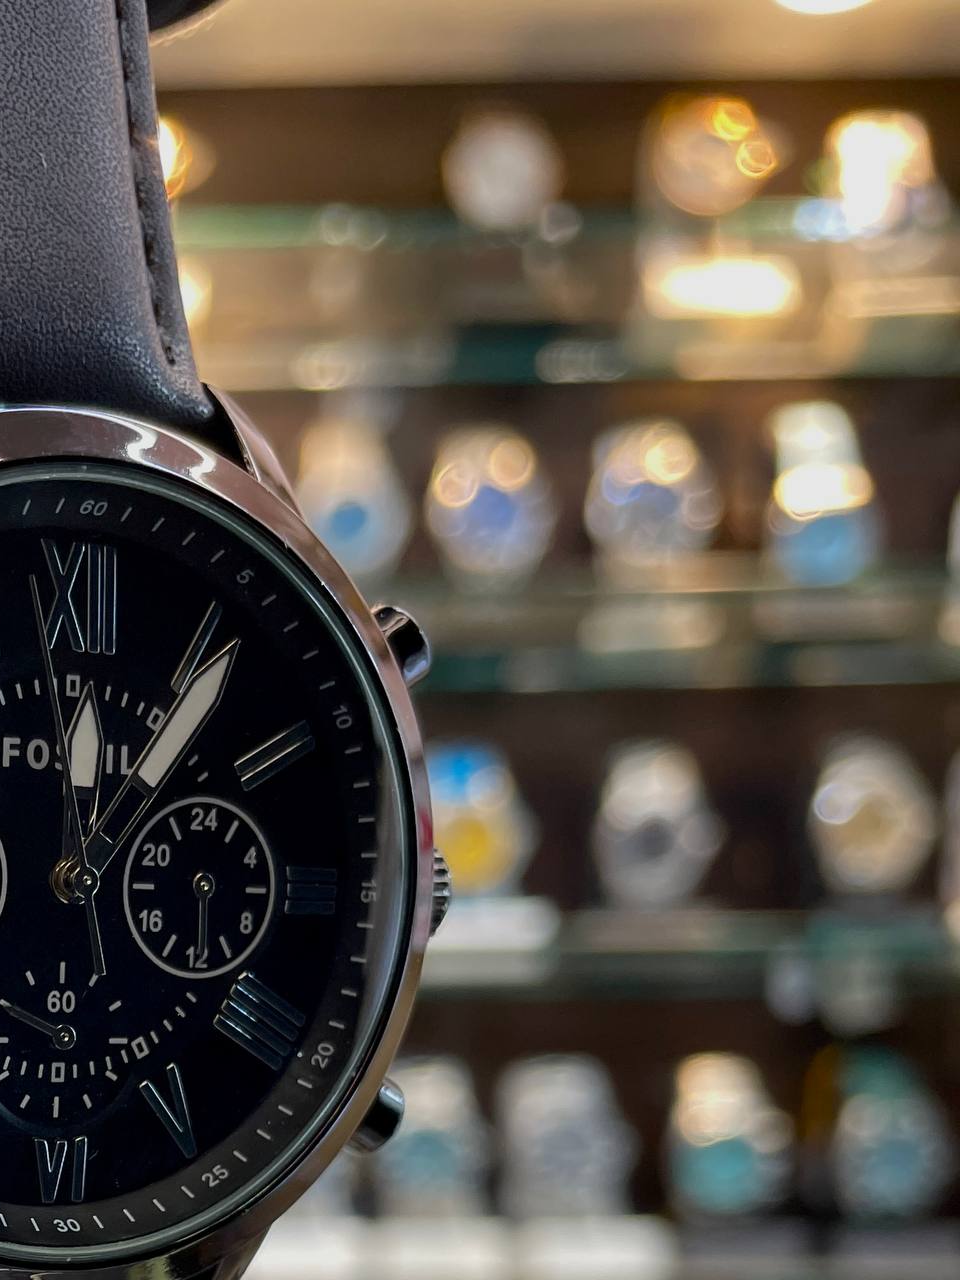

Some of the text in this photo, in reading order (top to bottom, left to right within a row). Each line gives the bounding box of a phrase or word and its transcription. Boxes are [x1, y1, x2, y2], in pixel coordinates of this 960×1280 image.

[80, 501, 108, 516] 60
[190, 807, 219, 832] 24
[141, 843, 171, 868] 20
[243, 845, 257, 869] 4
[139, 908, 163, 933] 16
[239, 910, 254, 935] 8
[47, 989, 75, 1013] 60
[311, 1042, 334, 1069] 20
[201, 1164, 229, 1188] 25
[53, 1217, 81, 1233] 30
